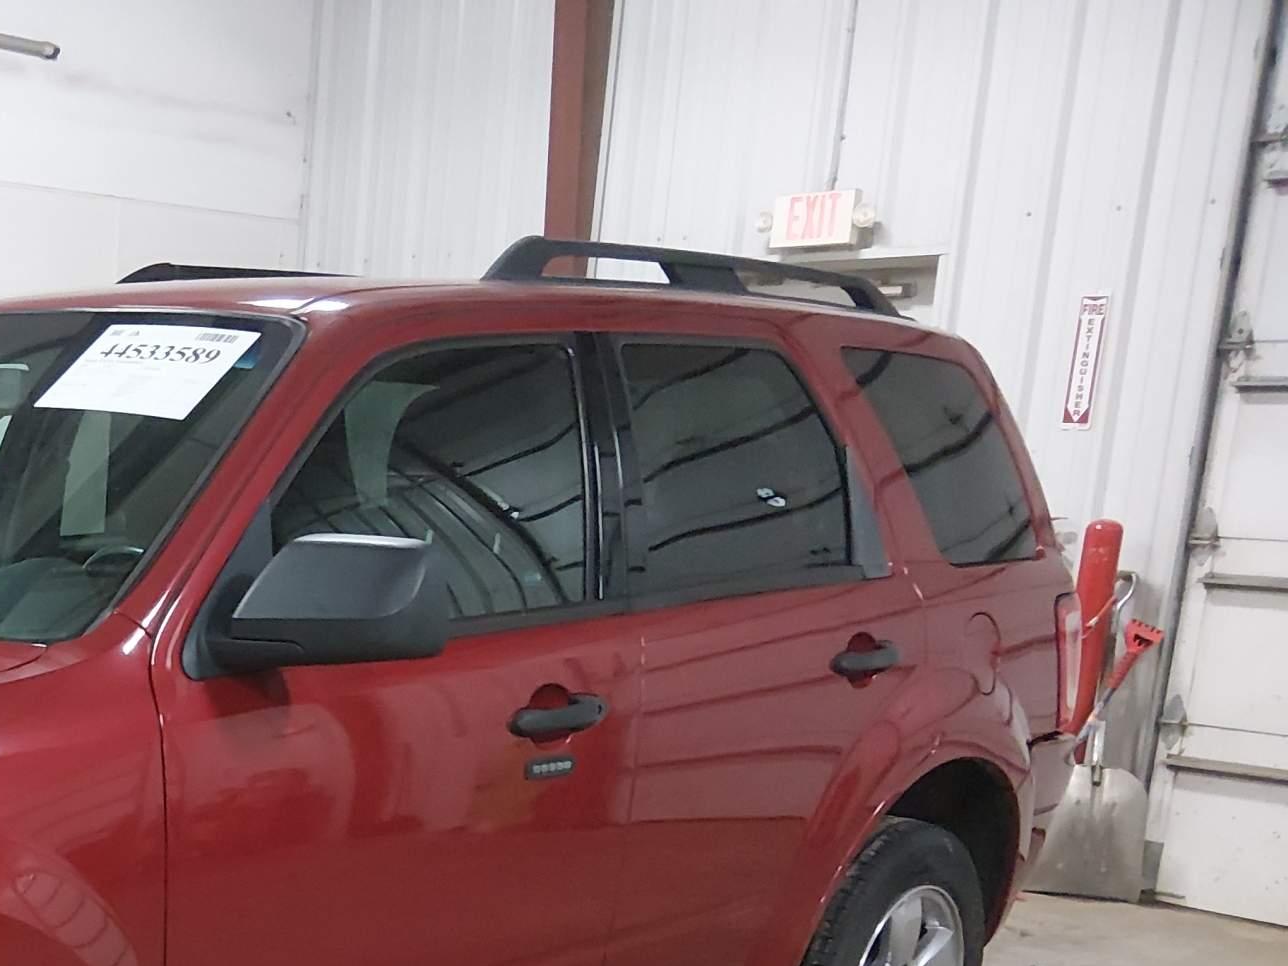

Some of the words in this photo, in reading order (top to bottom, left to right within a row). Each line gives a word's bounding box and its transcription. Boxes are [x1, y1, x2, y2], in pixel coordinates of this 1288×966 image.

[785, 192, 841, 240] EXIT
[1083, 303, 1105, 315] FIRE
[100, 343, 221, 365] 44533589
[1073, 318, 1095, 417] EXTINGUISHER
